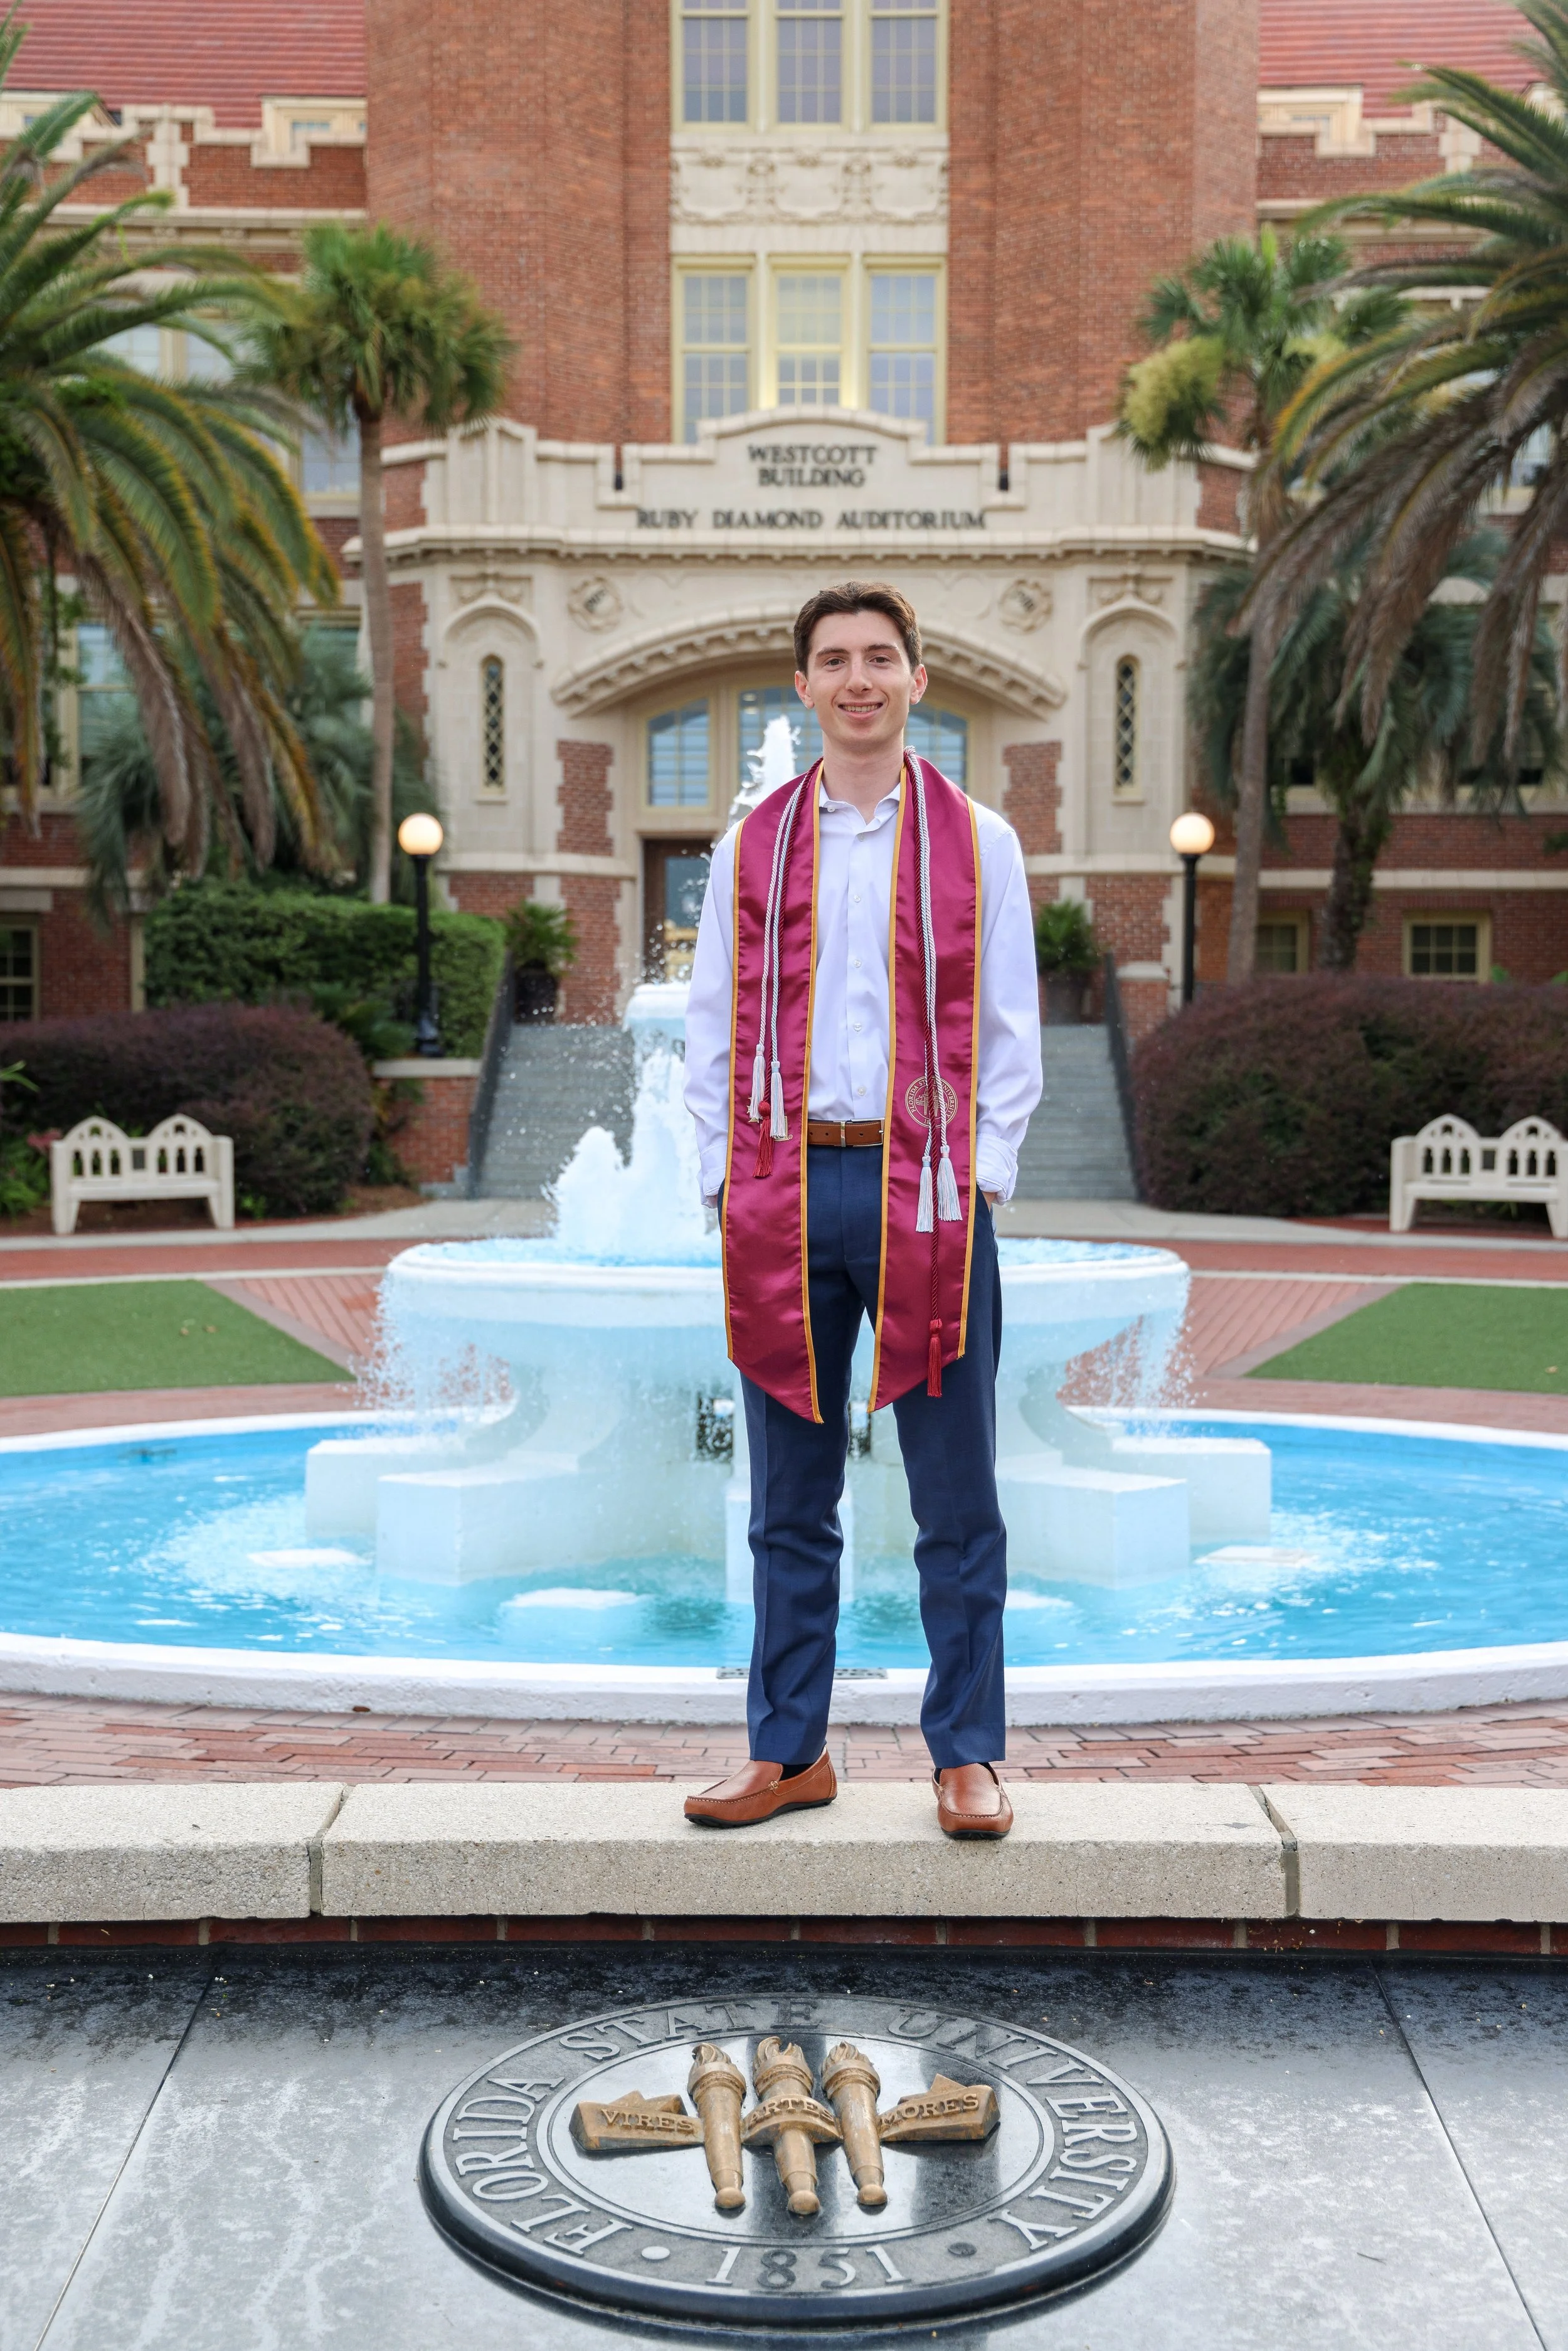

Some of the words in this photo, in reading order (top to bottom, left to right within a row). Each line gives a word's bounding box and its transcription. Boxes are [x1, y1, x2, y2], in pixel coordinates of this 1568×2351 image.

[748, 445, 877, 465] WESTCOTT
[759, 469, 866, 487] BUILDING
[637, 509, 698, 529] RUBY
[712, 509, 824, 529] DIAMOND
[836, 509, 987, 529] AUDITORIUM
[909, 1085, 918, 1113] FLORIDA
[601, 2109, 694, 2134] VIRES
[748, 2098, 835, 2130] ARTES
[878, 2093, 979, 2131] MORES
[453, 2077, 633, 2256] FLORIDA
[559, 2001, 818, 2061] STATE
[887, 2009, 1138, 2251] UNIVERSITY
[705, 2245, 911, 2289] 1851
